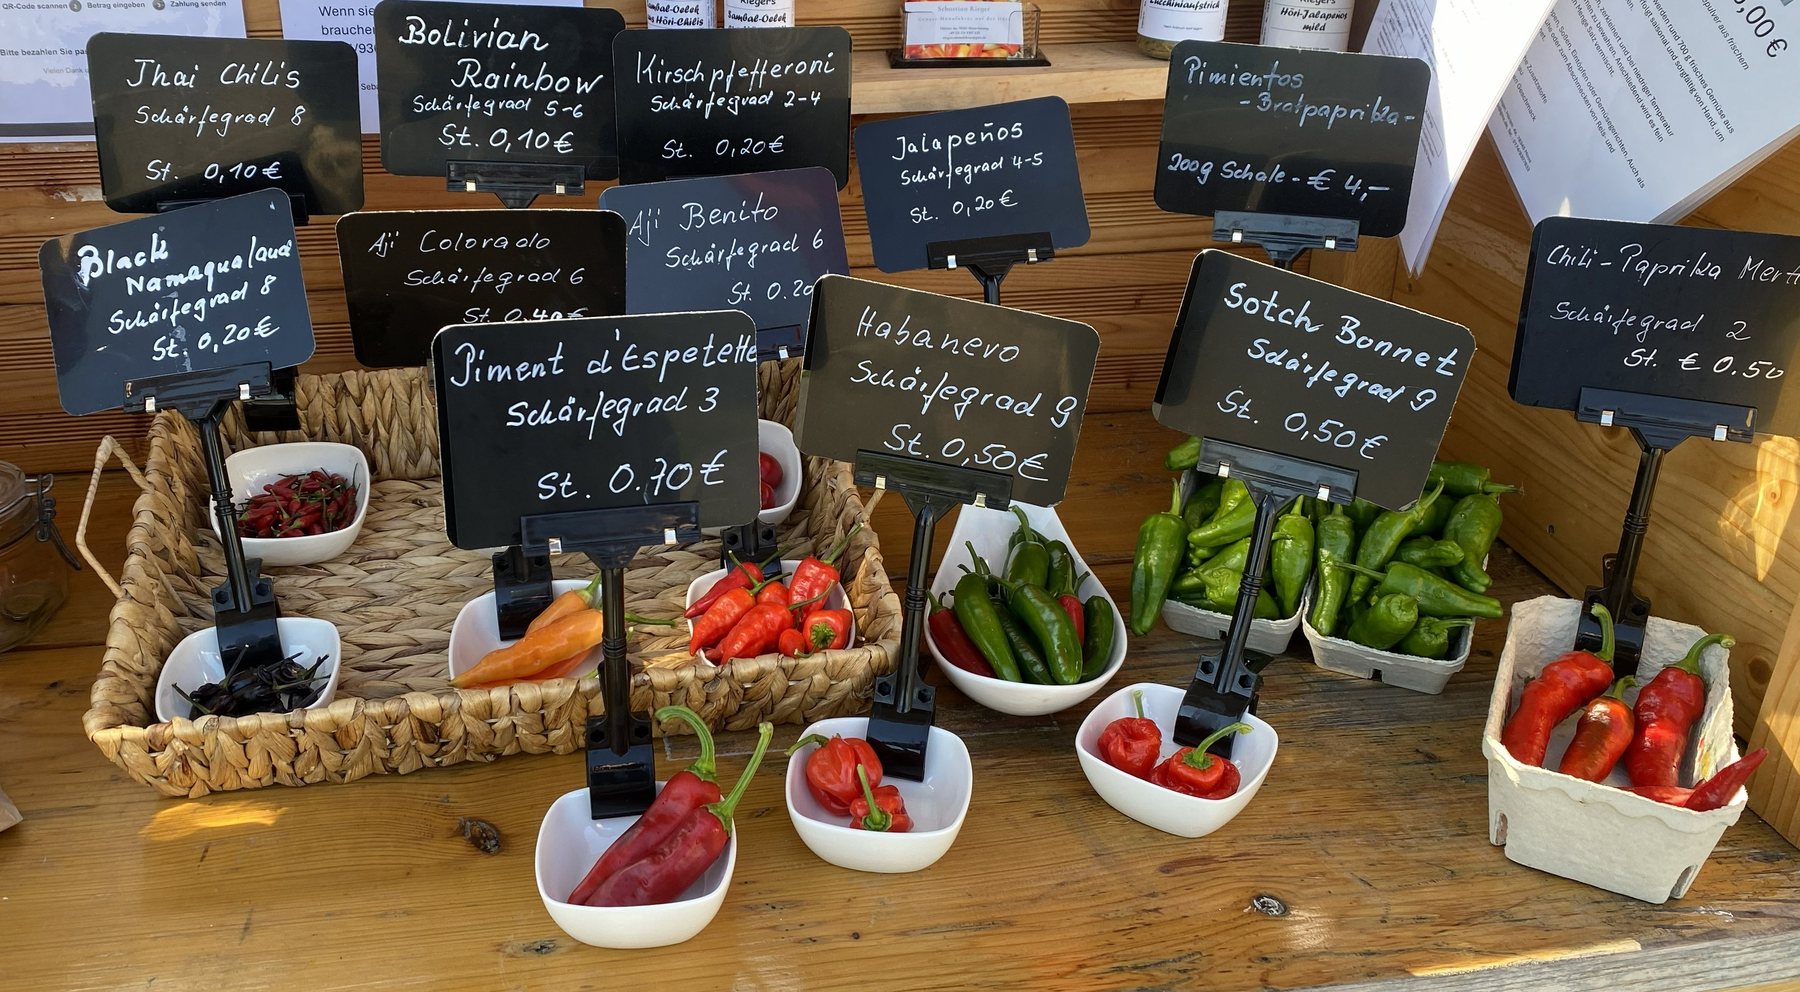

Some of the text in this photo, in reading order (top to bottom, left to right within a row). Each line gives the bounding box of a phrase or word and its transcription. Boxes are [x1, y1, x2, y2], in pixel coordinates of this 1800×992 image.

[87, 2, 111, 10] Betrag
[170, 0, 200, 9] Zahlung
[200, 0, 227, 8] senden
[318, 5, 356, 17] Wenn
[727, 10, 787, 23] Sambal-Oelek
[398, 16, 549, 51] Bolivian
[1302, 22, 1327, 32] mild
[1575, 3, 1589, 28] Menge
[1586, 25, 1597, 43] Salz
[21, 47, 58, 56] bezahlen
[59, 47, 73, 56] Sie
[1726, 37, 1750, 71] frischem
[451, 58, 603, 94] Rainbow
[637, 51, 835, 94] Kirschpfefferoni
[1184, 56, 1303, 91] Pimientos
[1526, 63, 1548, 104] Zusatzstoffe
[1599, 6, 1674, 137] zerkleinert und bei niedriger Temperatur
[1649, 16, 1670, 48] saisonal
[1666, 45, 1679, 61] und
[1674, 60, 1697, 95] sorgfältig
[1693, 91, 1705, 108] von
[1701, 105, 1718, 130] Hand,
[1714, 128, 1725, 143] um
[1667, 23, 1681, 42] rund
[1677, 39, 1689, 55] 700
[1688, 59, 1709, 89] frisches
[1705, 87, 1726, 120] Gemüse
[1723, 119, 1735, 134] aus
[413, 94, 583, 118] Schärfegrad 5-6
[651, 90, 821, 119] Schärfegrad 2-4
[1516, 82, 1537, 123] Geschmack
[1550, 32, 1561, 48] oder
[1558, 47, 1569, 63] zum
[1565, 62, 1592, 110] Abschmecken
[1589, 108, 1599, 122] von
[1604, 138, 1616, 154] und
[1558, 25, 1573, 51] Soßen,
[1570, 48, 1589, 83] Eintöpfen
[1586, 81, 1598, 98] oder
[1626, 158, 1639, 178] Auch
[1636, 176, 1646, 189] als
[1614, 57, 1644, 104] Anschließend
[1639, 102, 1652, 120] wird
[1653, 127, 1664, 143] fein
[135, 105, 306, 137] Schärfegrad 8
[438, 124, 479, 149] St.
[662, 139, 692, 158] St.
[892, 122, 1023, 166] Jalapeños
[146, 160, 178, 181] St.
[901, 152, 1043, 189] Schärfegrad 4-5
[1168, 153, 1213, 184] 200g
[680, 192, 778, 230] Benito
[910, 207, 938, 223] St.
[420, 230, 550, 252] Colorado
[665, 229, 823, 271] Schärfegrad 6
[77, 233, 168, 287] Black
[404, 267, 585, 294] Schärfegrad 6
[728, 282, 751, 304] St.
[108, 275, 276, 336] Schärfegrad 8
[1550, 302, 1751, 343] Schärfegrad 2
[152, 314, 280, 361] St. 0,20€
[1224, 283, 1460, 379] Sotch Bonnet
[450, 342, 564, 387] Piment
[1624, 349, 1784, 379] St. € 0.50
[850, 357, 1042, 420] Schärfegrad
[1410, 389, 1436, 411] 9
[506, 386, 719, 440] Schärfegrad 3
[1217, 390, 1258, 424] St.
[884, 424, 1048, 481] St. 0,50€
[538, 472, 590, 500] St.
